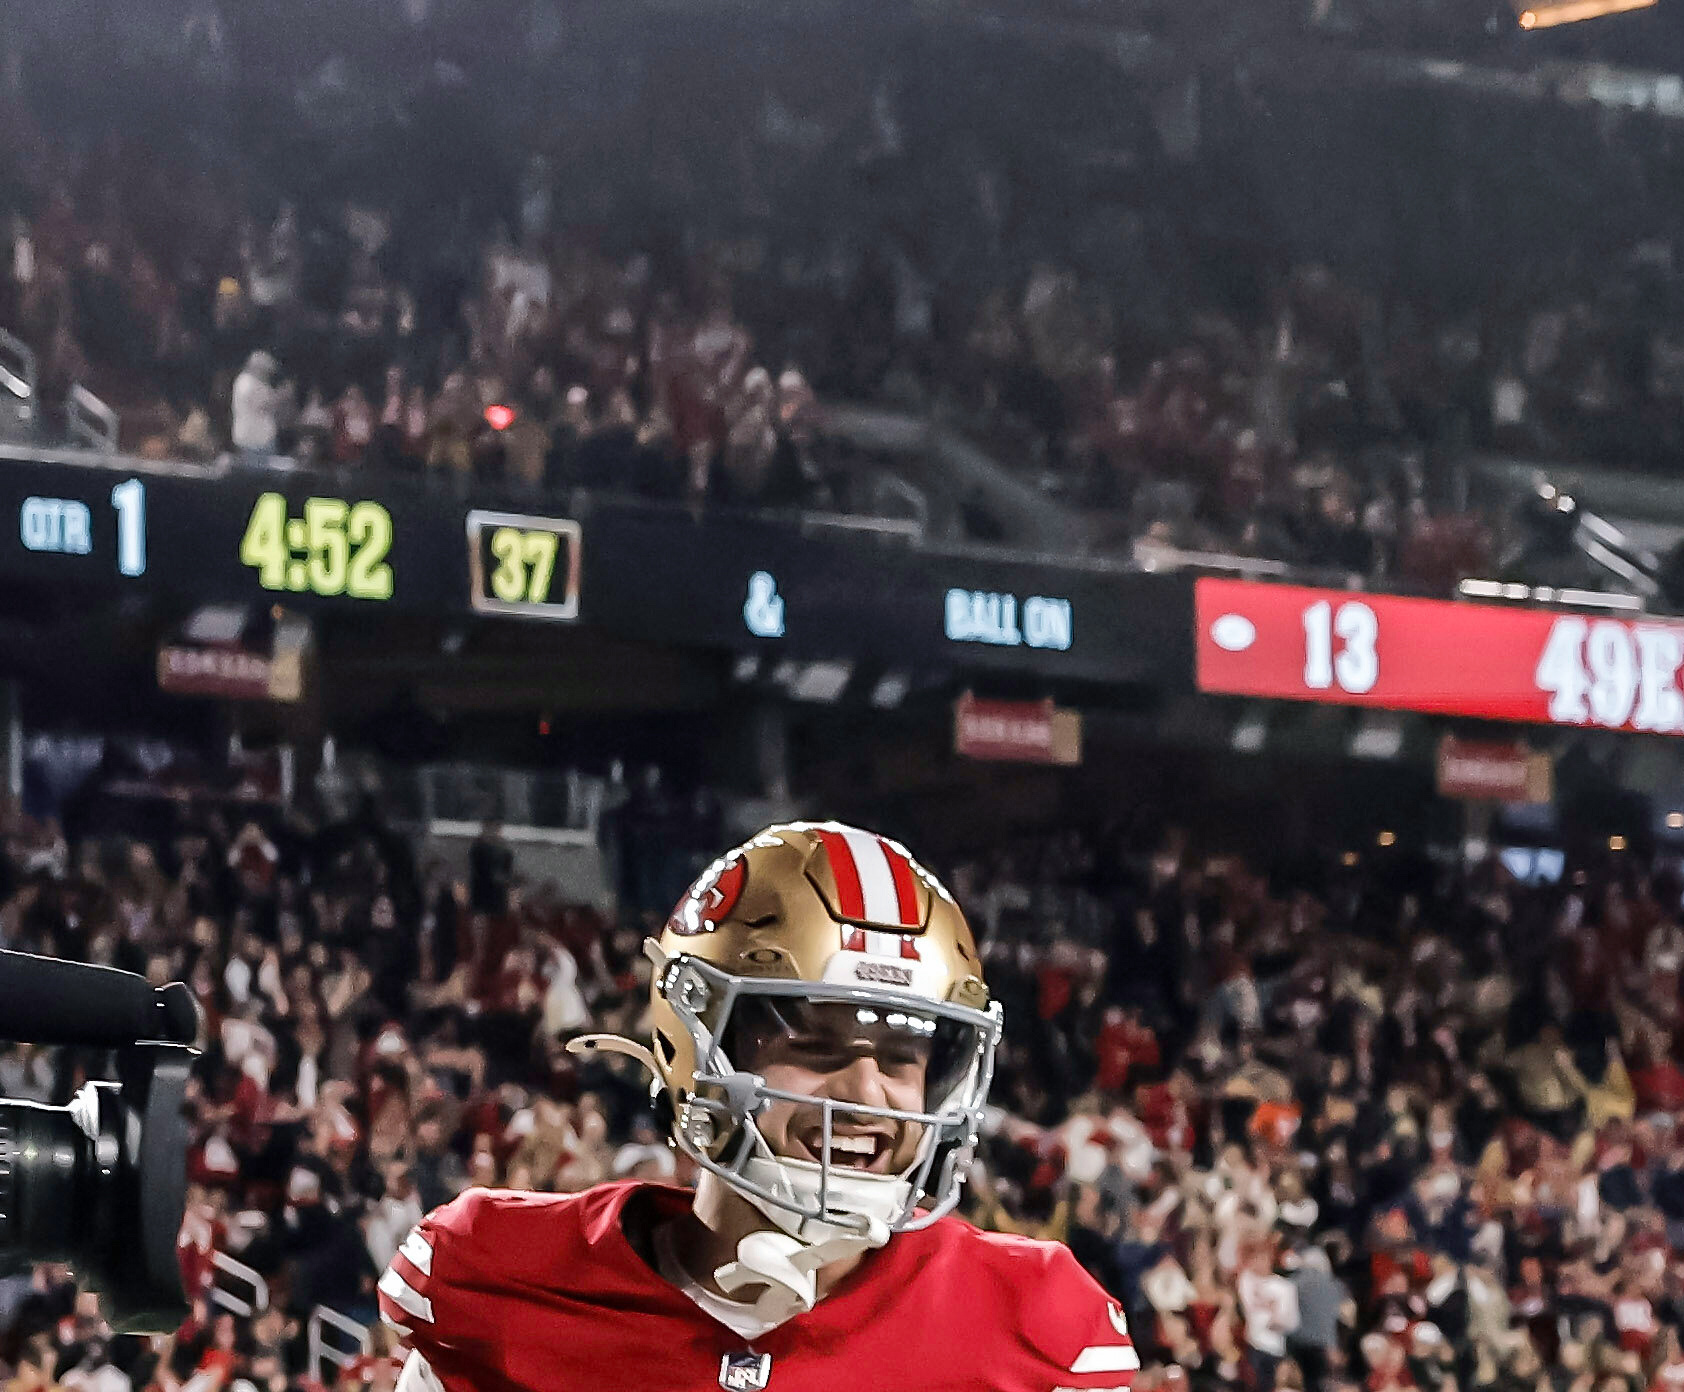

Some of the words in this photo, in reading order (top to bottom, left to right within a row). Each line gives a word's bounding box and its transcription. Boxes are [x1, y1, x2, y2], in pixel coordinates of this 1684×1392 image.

[112, 478, 146, 577] 1
[240, 492, 394, 600] 4:52
[491, 527, 558, 603] 37
[744, 570, 785, 638] &
[1303, 600, 1380, 694] 13
